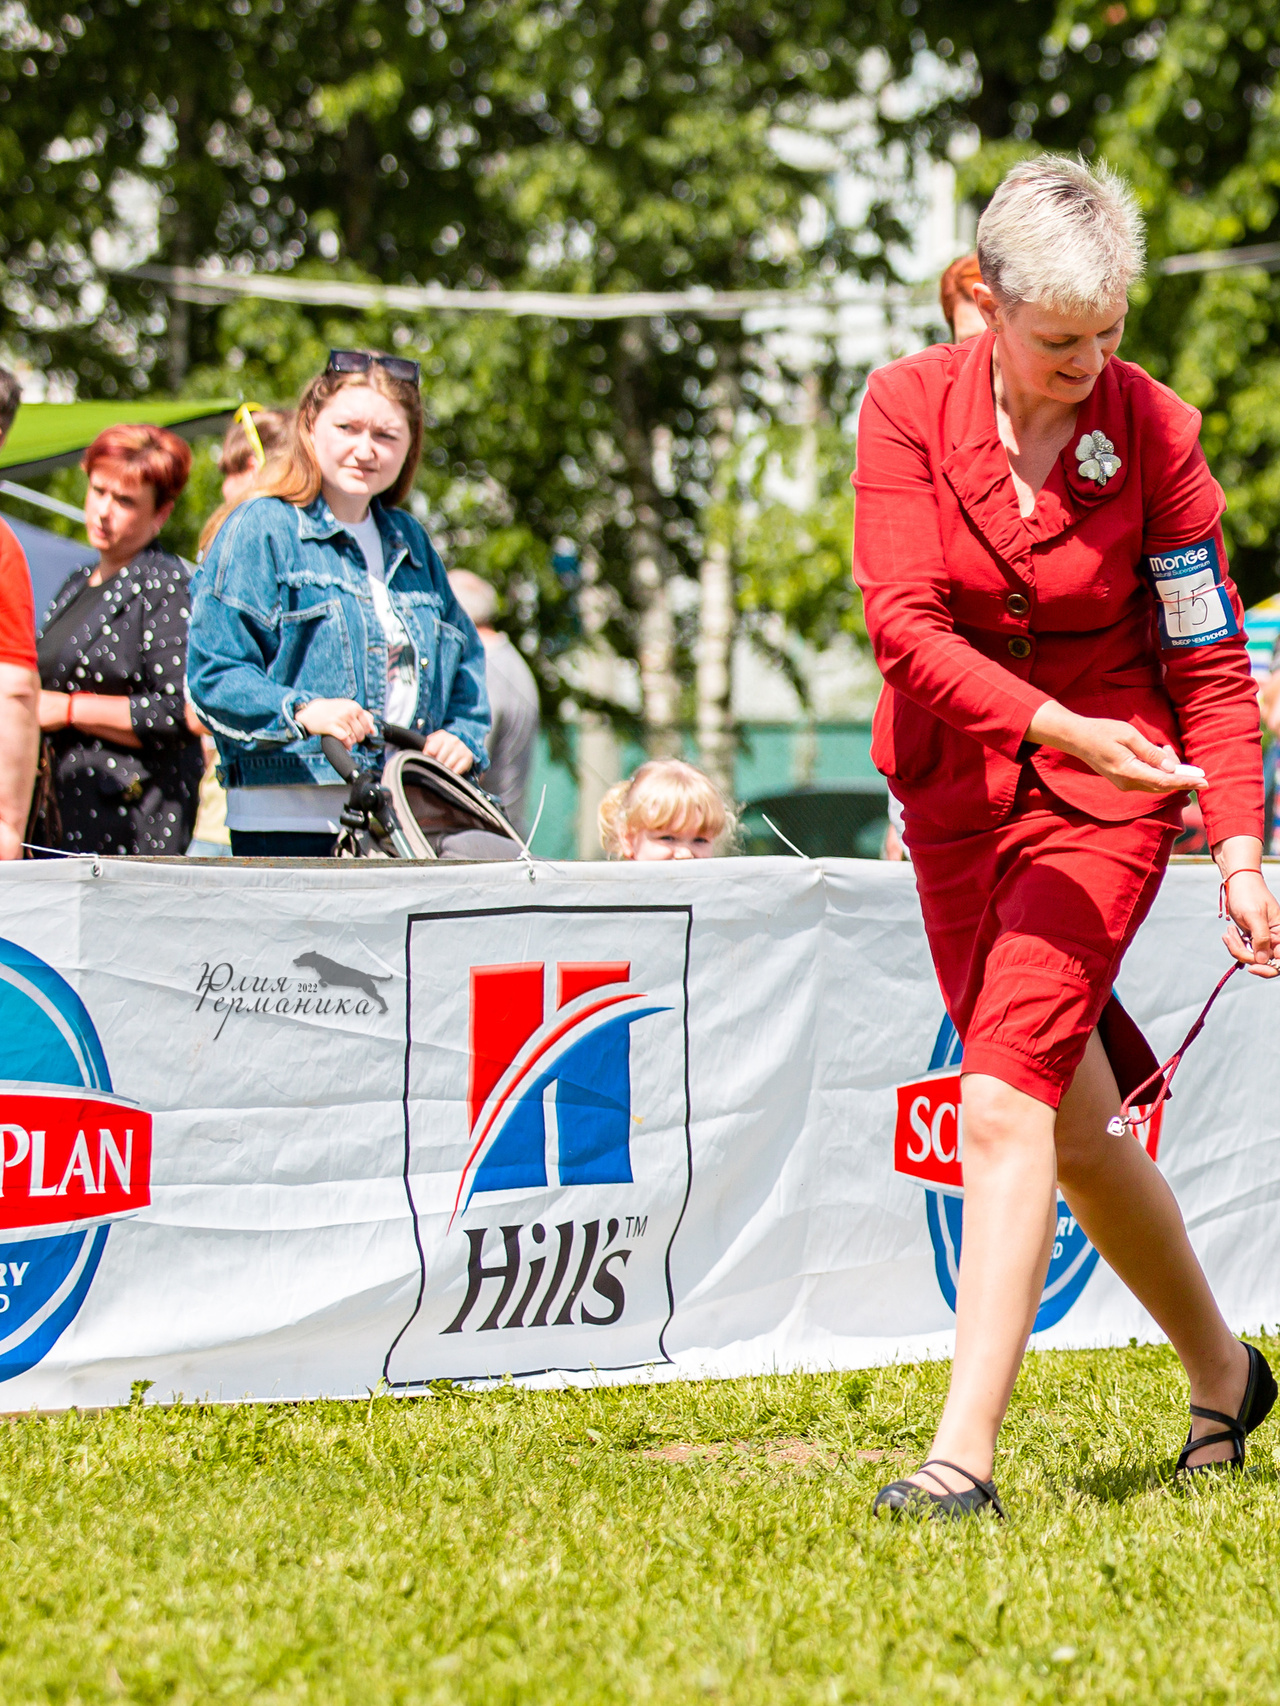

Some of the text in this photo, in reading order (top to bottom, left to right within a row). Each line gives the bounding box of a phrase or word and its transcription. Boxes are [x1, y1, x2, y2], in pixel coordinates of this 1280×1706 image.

[1164, 582, 1208, 633] 75
[0, 1123, 134, 1198] PLAN
[438, 1217, 632, 1335] Hill's
